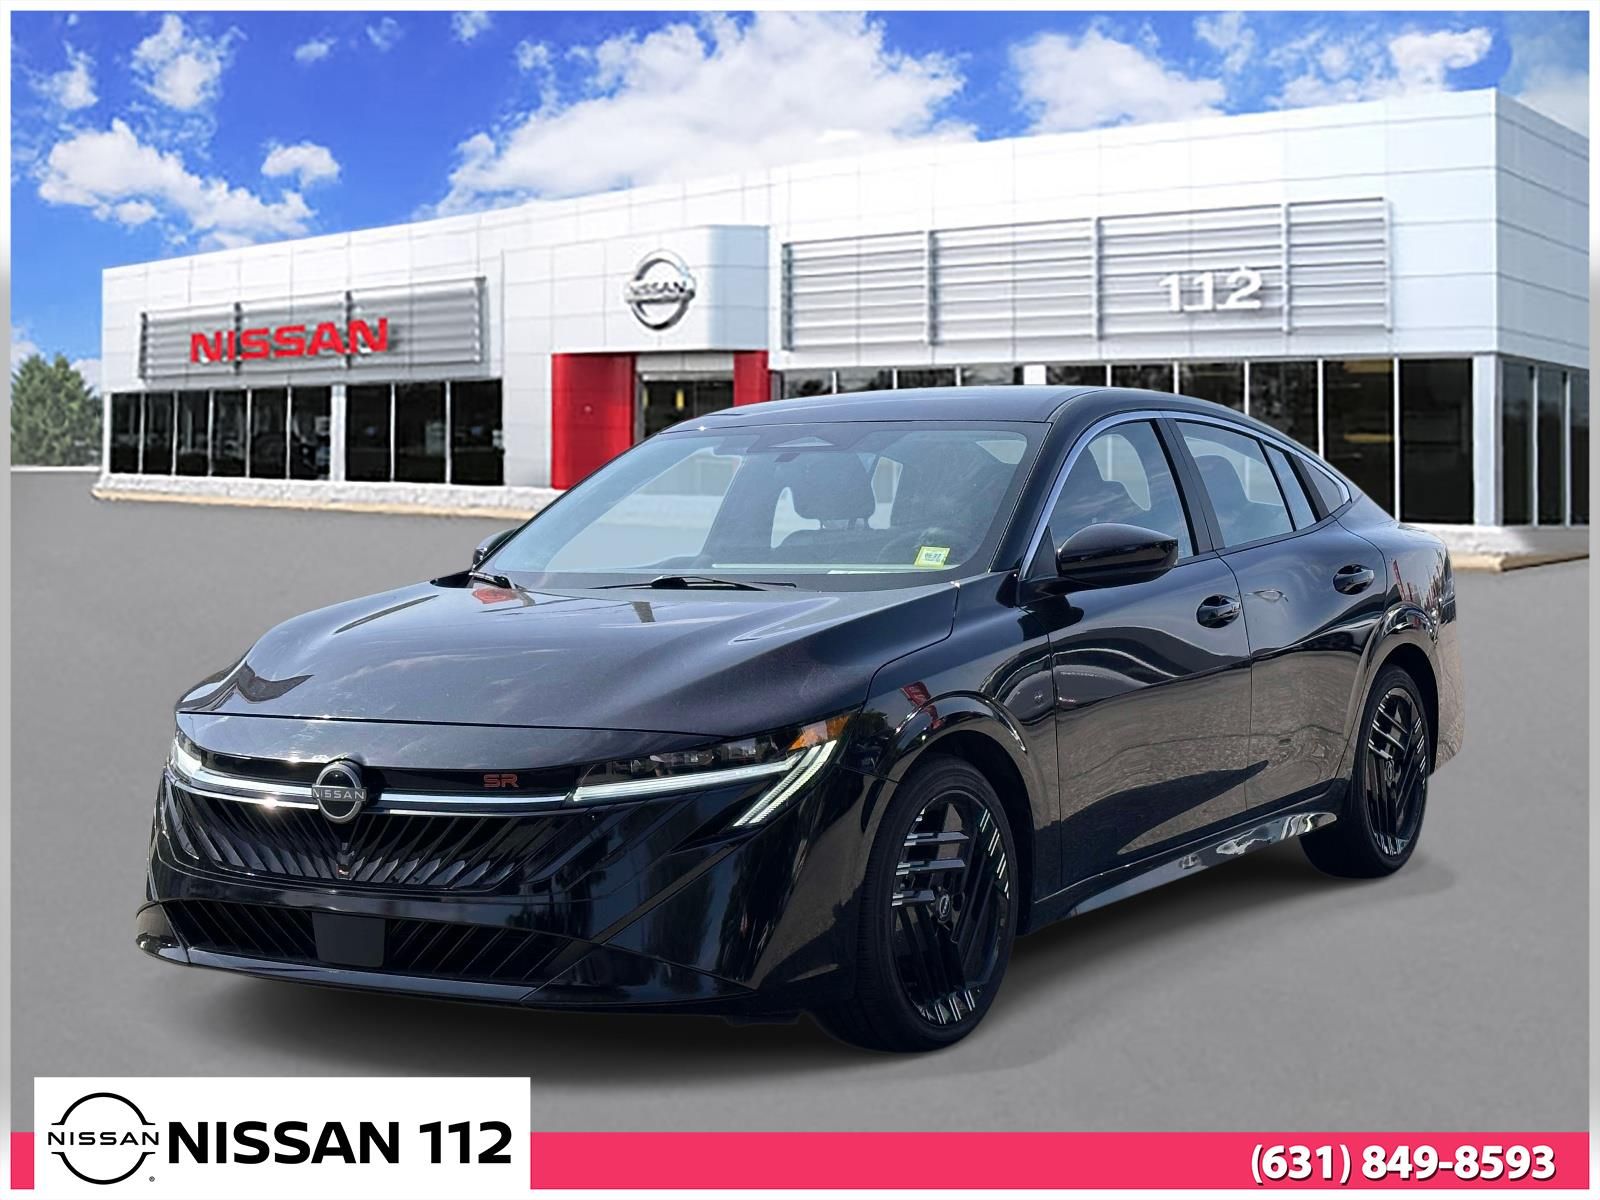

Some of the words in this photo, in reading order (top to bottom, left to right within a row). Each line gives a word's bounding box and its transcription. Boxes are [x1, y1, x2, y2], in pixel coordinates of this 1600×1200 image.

[627, 281, 691, 297] NISSAN
[1159, 270, 1262, 312] 112
[190, 317, 388, 363] NISSAN
[483, 773, 519, 788] SR
[312, 787, 365, 800] NISSAN
